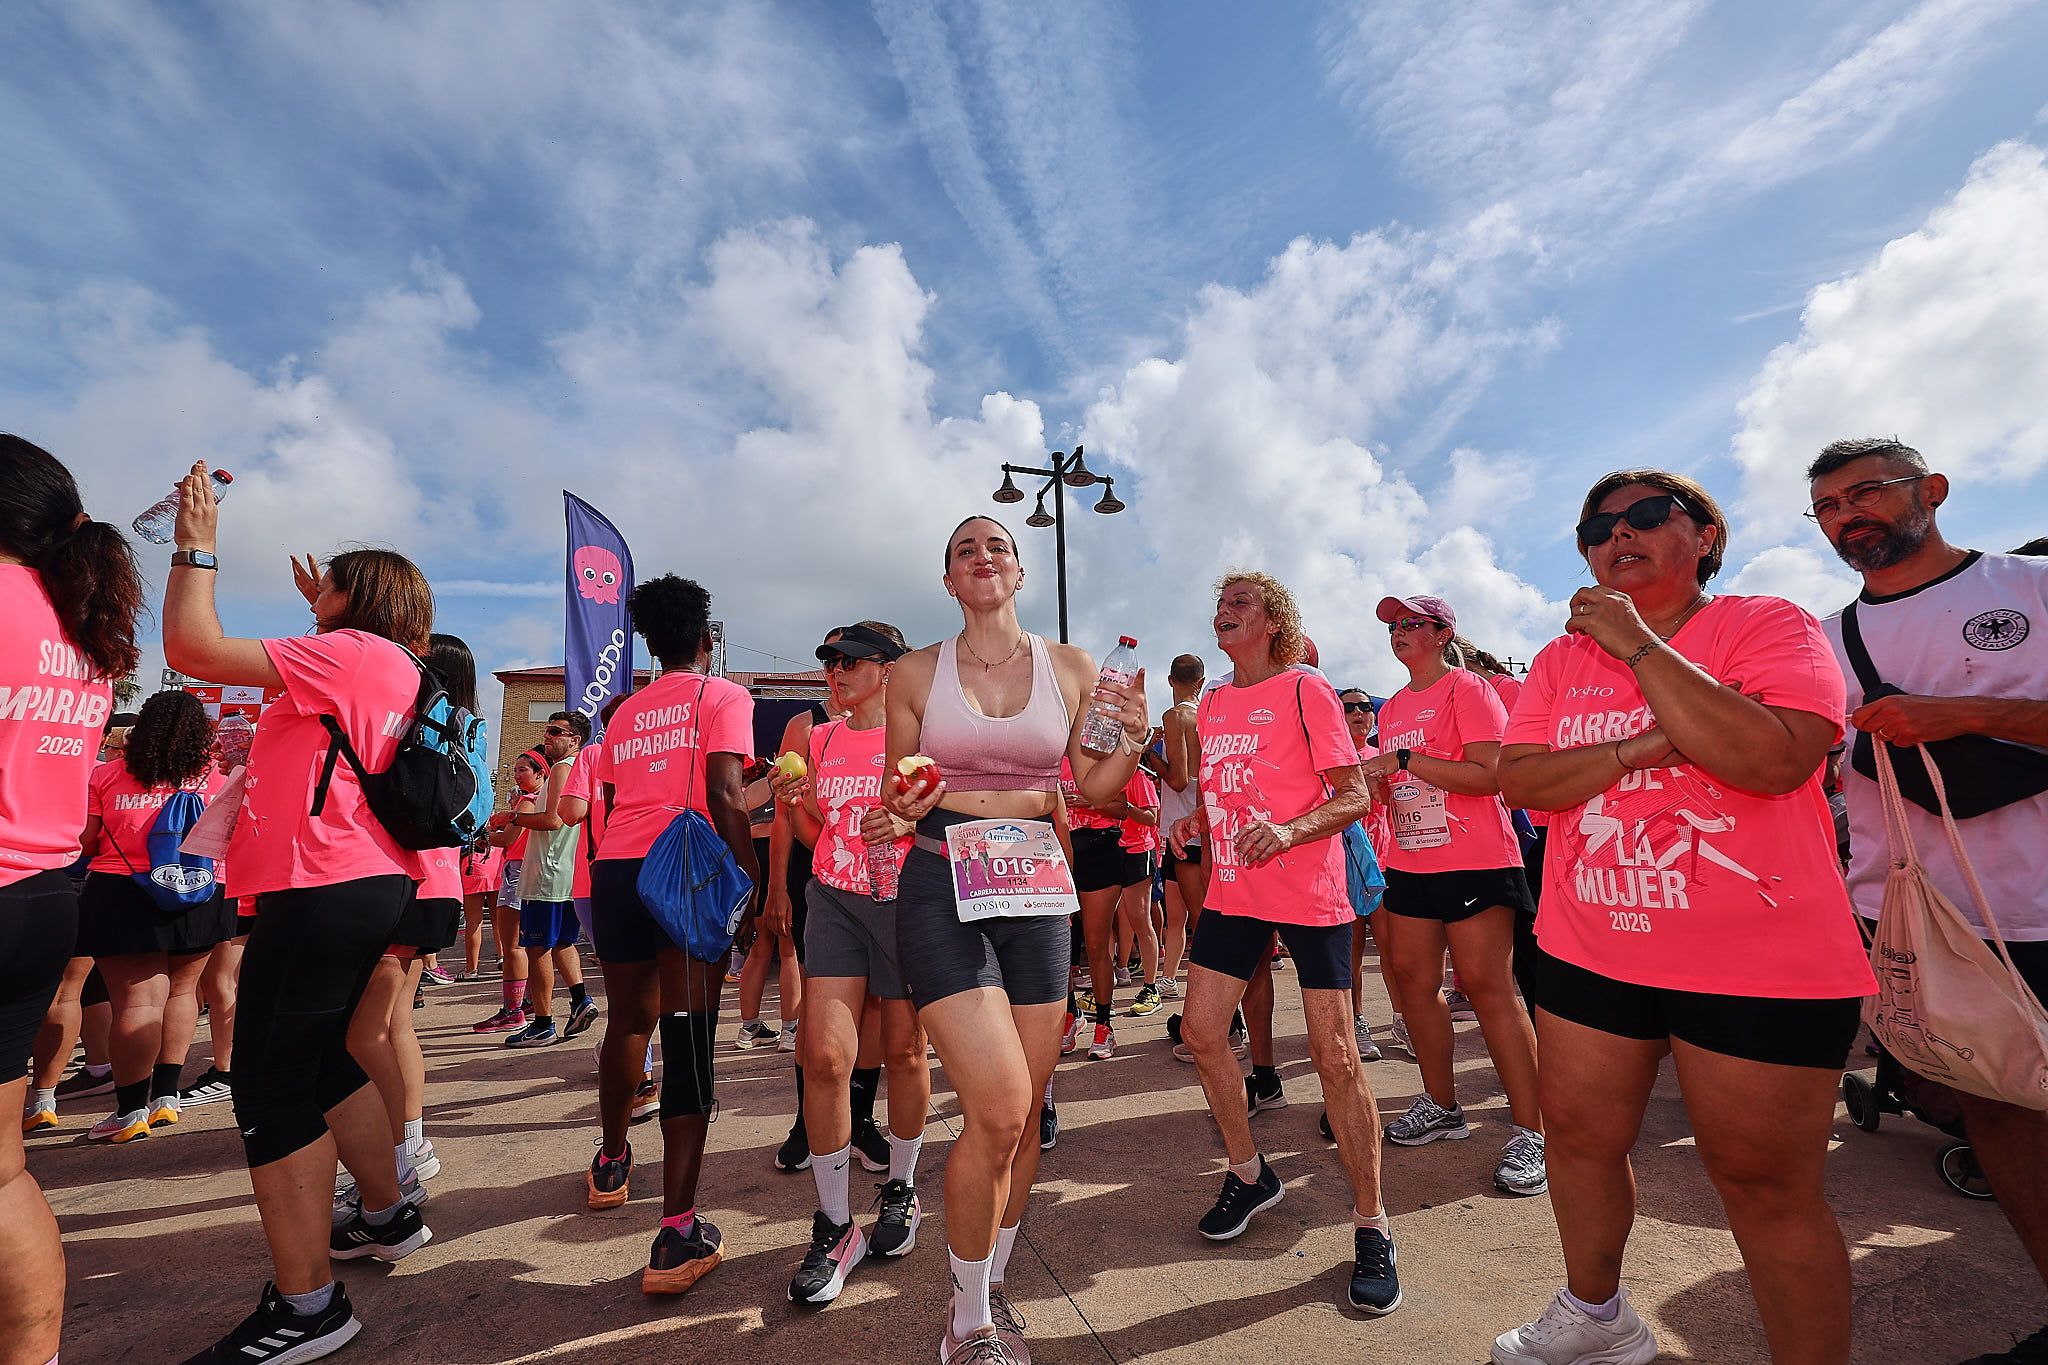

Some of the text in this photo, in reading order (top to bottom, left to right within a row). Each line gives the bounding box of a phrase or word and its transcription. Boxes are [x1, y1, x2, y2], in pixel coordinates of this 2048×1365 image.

[39, 639, 113, 689] SOM
[1566, 684, 1614, 699] YSHO
[633, 702, 692, 732] SOMOS
[36, 735, 84, 757] 2026
[613, 727, 701, 765] IMPARABLE
[1201, 733, 1260, 755] ARRERA
[648, 758, 669, 773] 2026
[1399, 811, 1422, 824] 016
[958, 830, 981, 840] SUMA
[1615, 819, 1656, 867] LA
[992, 858, 1036, 876] 016
[157, 868, 208, 886] ASTRIANA
[1007, 877, 1028, 886] 1134
[969, 887, 997, 898] CARRERA
[998, 887, 1006, 895] DE
[1015, 887, 1034, 895] MUJER
[1038, 886, 1063, 894] VALENCIA
[1575, 867, 1690, 910] MUJER
[972, 901, 1010, 912] OYSHO
[1032, 900, 1065, 909] Santander
[1609, 911, 1652, 933] 2026
